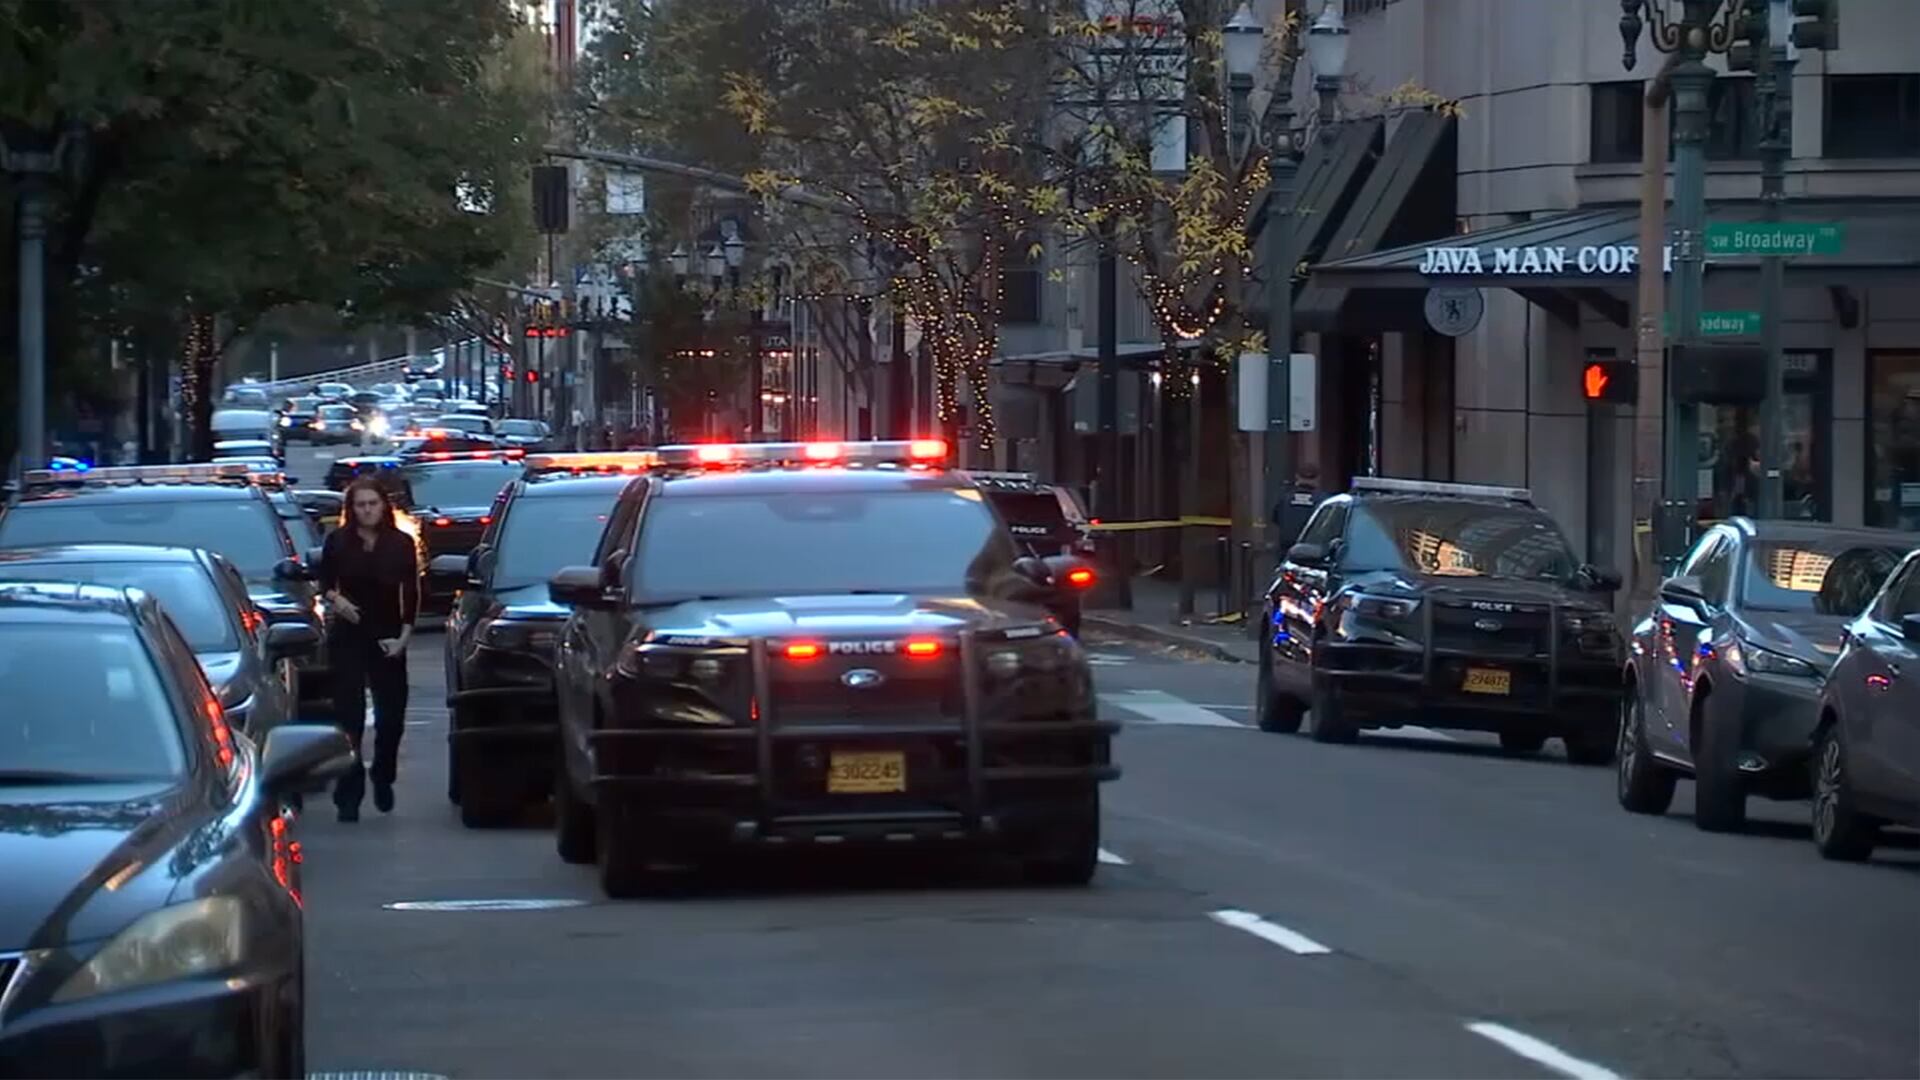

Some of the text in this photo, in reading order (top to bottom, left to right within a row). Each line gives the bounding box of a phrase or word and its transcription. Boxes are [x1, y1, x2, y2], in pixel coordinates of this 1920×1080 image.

[1734, 230, 1815, 255] Broadway
[1419, 247, 1483, 274] JAVA
[1011, 526, 1047, 535] POLICE
[1471, 601, 1513, 613] POLICE
[828, 640, 897, 654] POLICE
